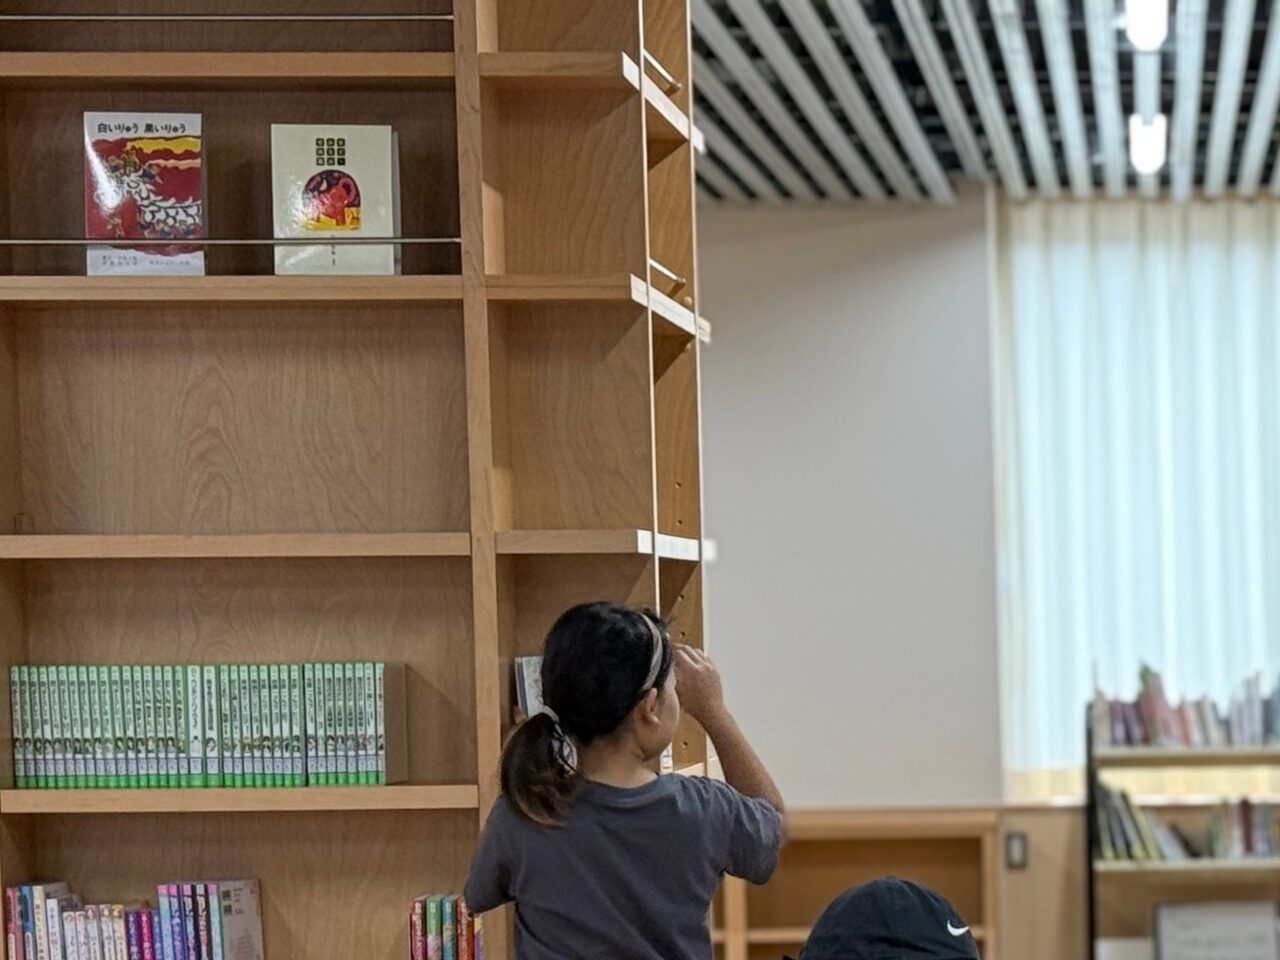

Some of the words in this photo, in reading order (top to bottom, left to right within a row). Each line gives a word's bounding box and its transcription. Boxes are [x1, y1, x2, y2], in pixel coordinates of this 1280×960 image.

[97, 123, 139, 133] 白いりゅう
